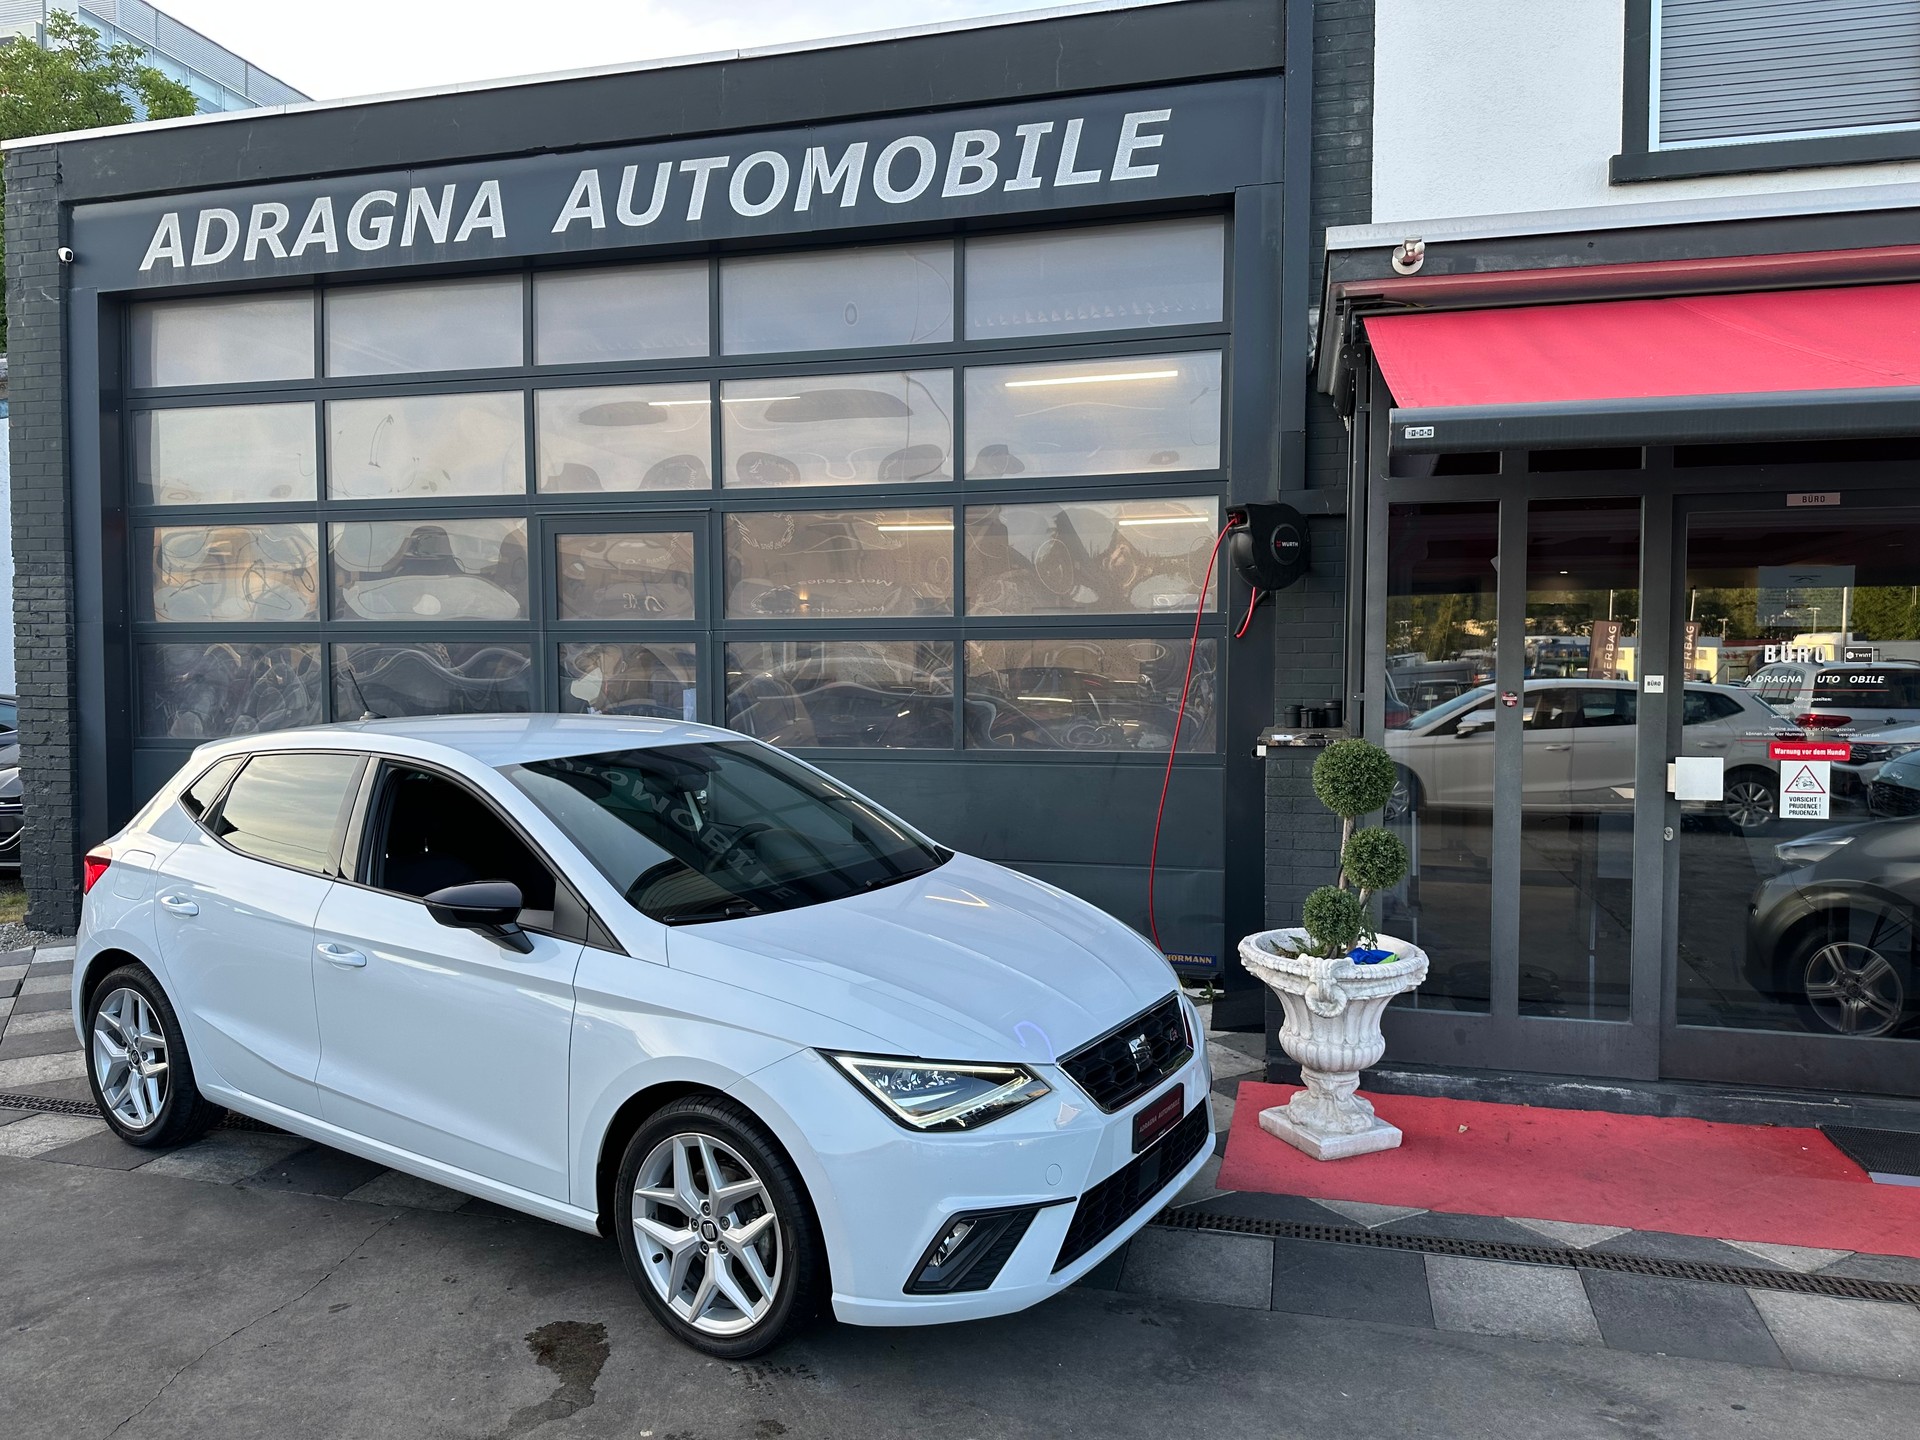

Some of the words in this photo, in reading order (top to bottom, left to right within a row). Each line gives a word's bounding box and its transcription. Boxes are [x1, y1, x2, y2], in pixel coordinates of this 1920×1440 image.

[139, 179, 506, 271] ADRAGNA
[551, 108, 1172, 233] AUTOMOBILE
[1802, 495, 1826, 503] BÜRO
[1764, 642, 1826, 663] BÜRO
[1774, 748, 1801, 756] Warnung
[1827, 748, 1846, 756] Hunde
